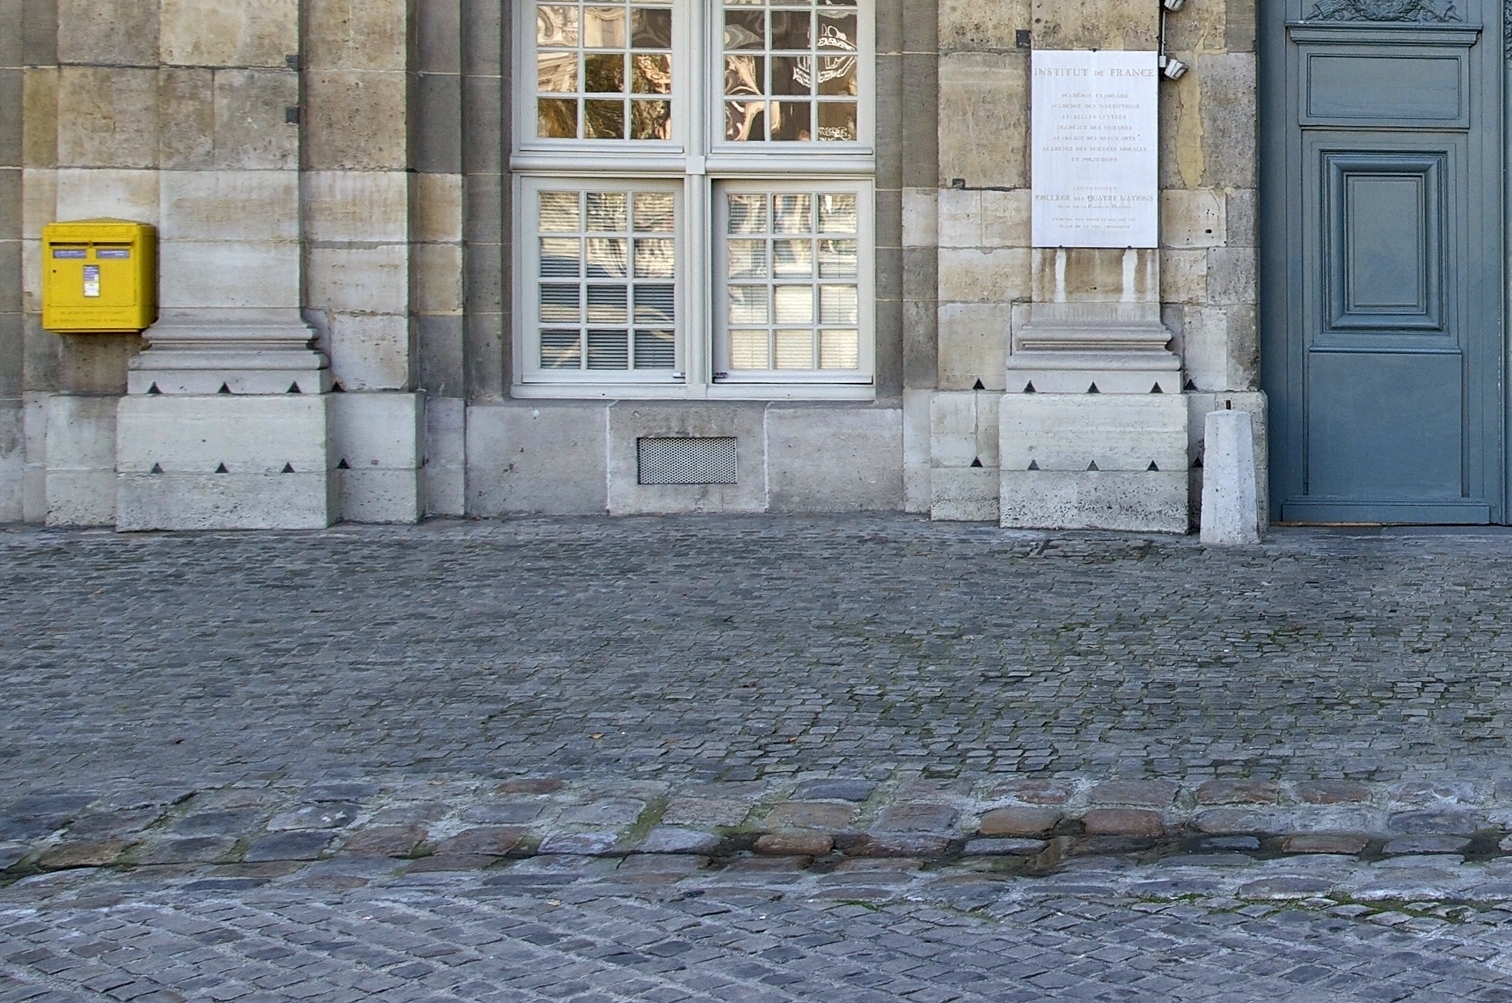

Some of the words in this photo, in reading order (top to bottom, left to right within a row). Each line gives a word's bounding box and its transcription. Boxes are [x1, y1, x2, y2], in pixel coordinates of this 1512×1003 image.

[1034, 67, 1089, 77] INSTITUT
[1094, 69, 1105, 77] DE
[1110, 67, 1154, 77] FRANCE
